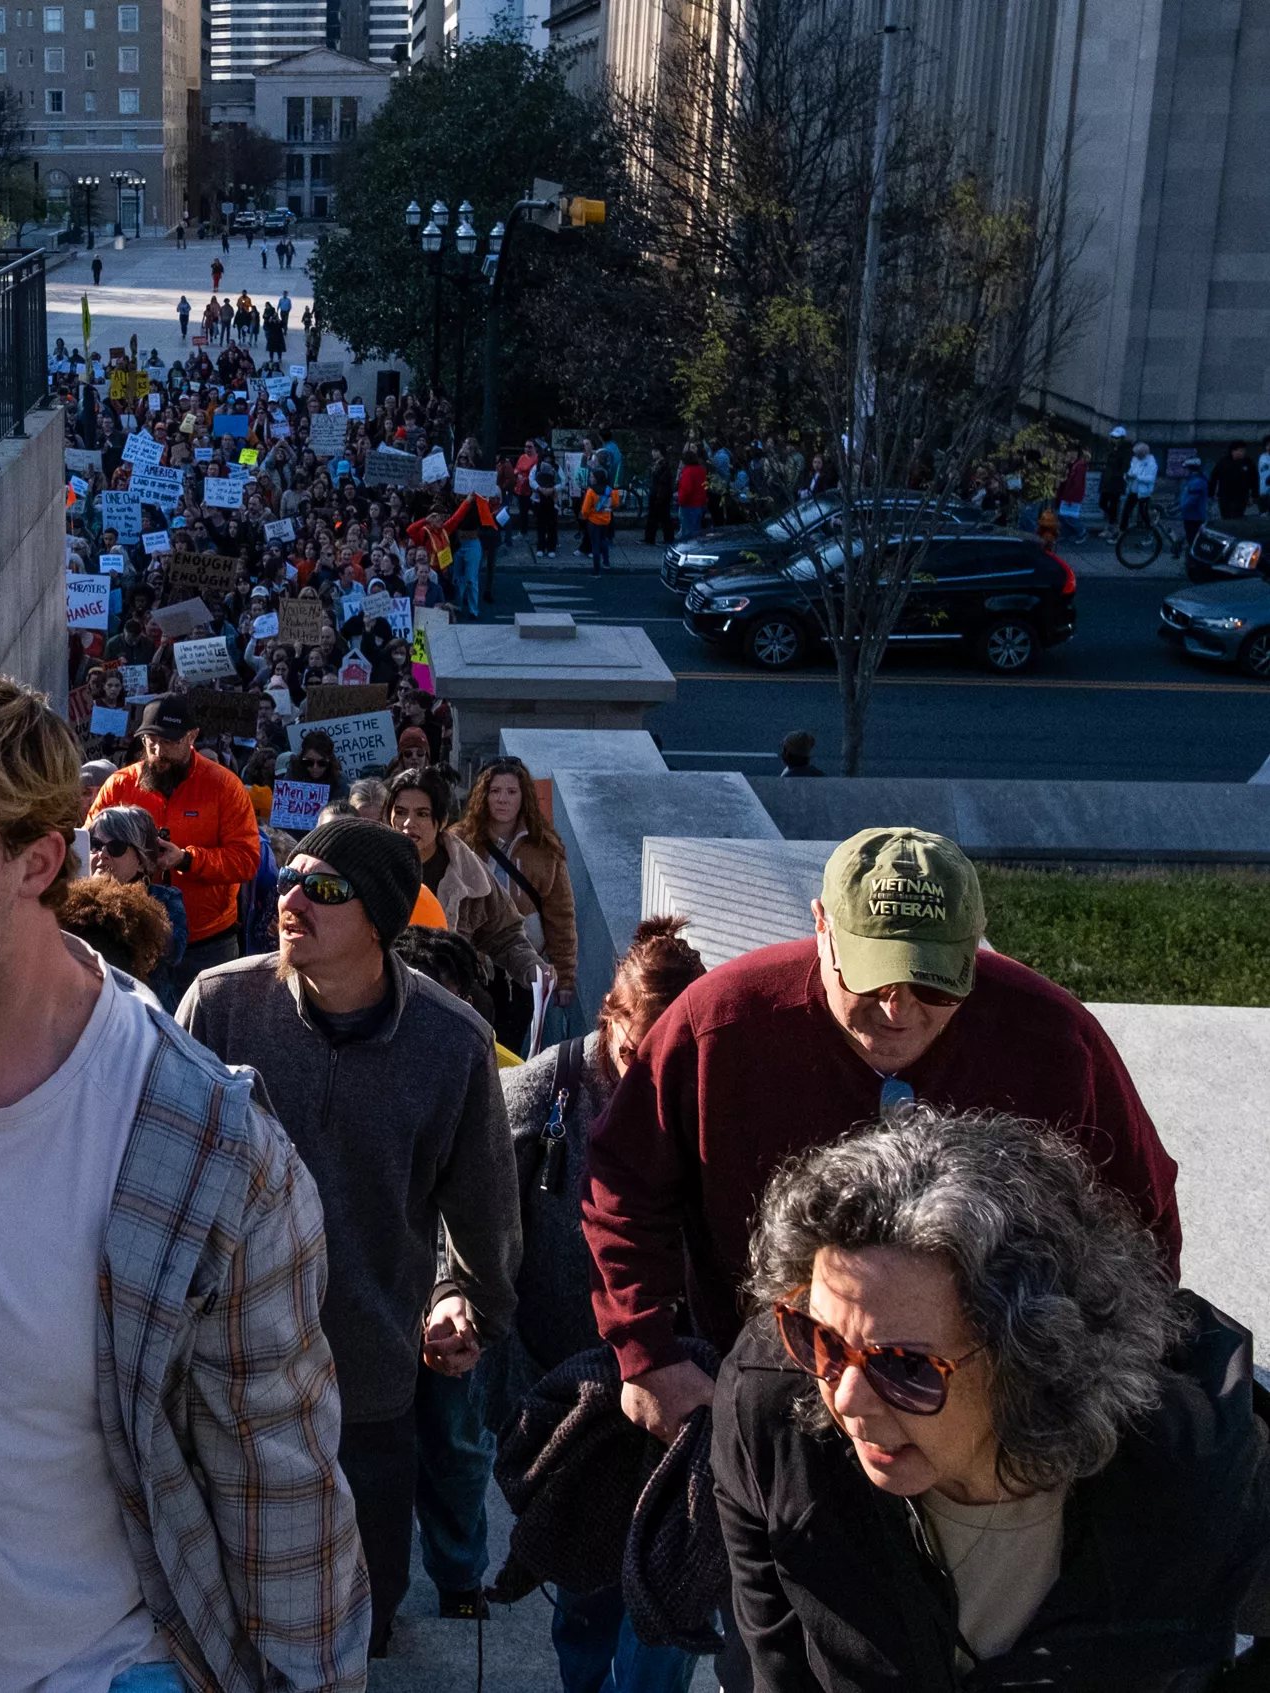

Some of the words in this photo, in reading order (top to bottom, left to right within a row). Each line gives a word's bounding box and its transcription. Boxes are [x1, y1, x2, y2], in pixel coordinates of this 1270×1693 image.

[143, 464, 178, 481] AMERICA
[133, 477, 149, 487] LAND
[105, 492, 122, 505] ONE
[174, 552, 233, 572] ENOUGH
[171, 571, 230, 587] ENOUGH
[281, 627, 319, 643] Children
[214, 647, 228, 657] LEE
[353, 718, 380, 732] THE
[334, 733, 385, 754] GRADER
[349, 750, 377, 764] THE
[275, 782, 304, 801] When
[309, 786, 325, 802] will
[288, 800, 321, 816] END?
[871, 878, 945, 899] VIETNAM
[868, 900, 946, 921] VETERAN
